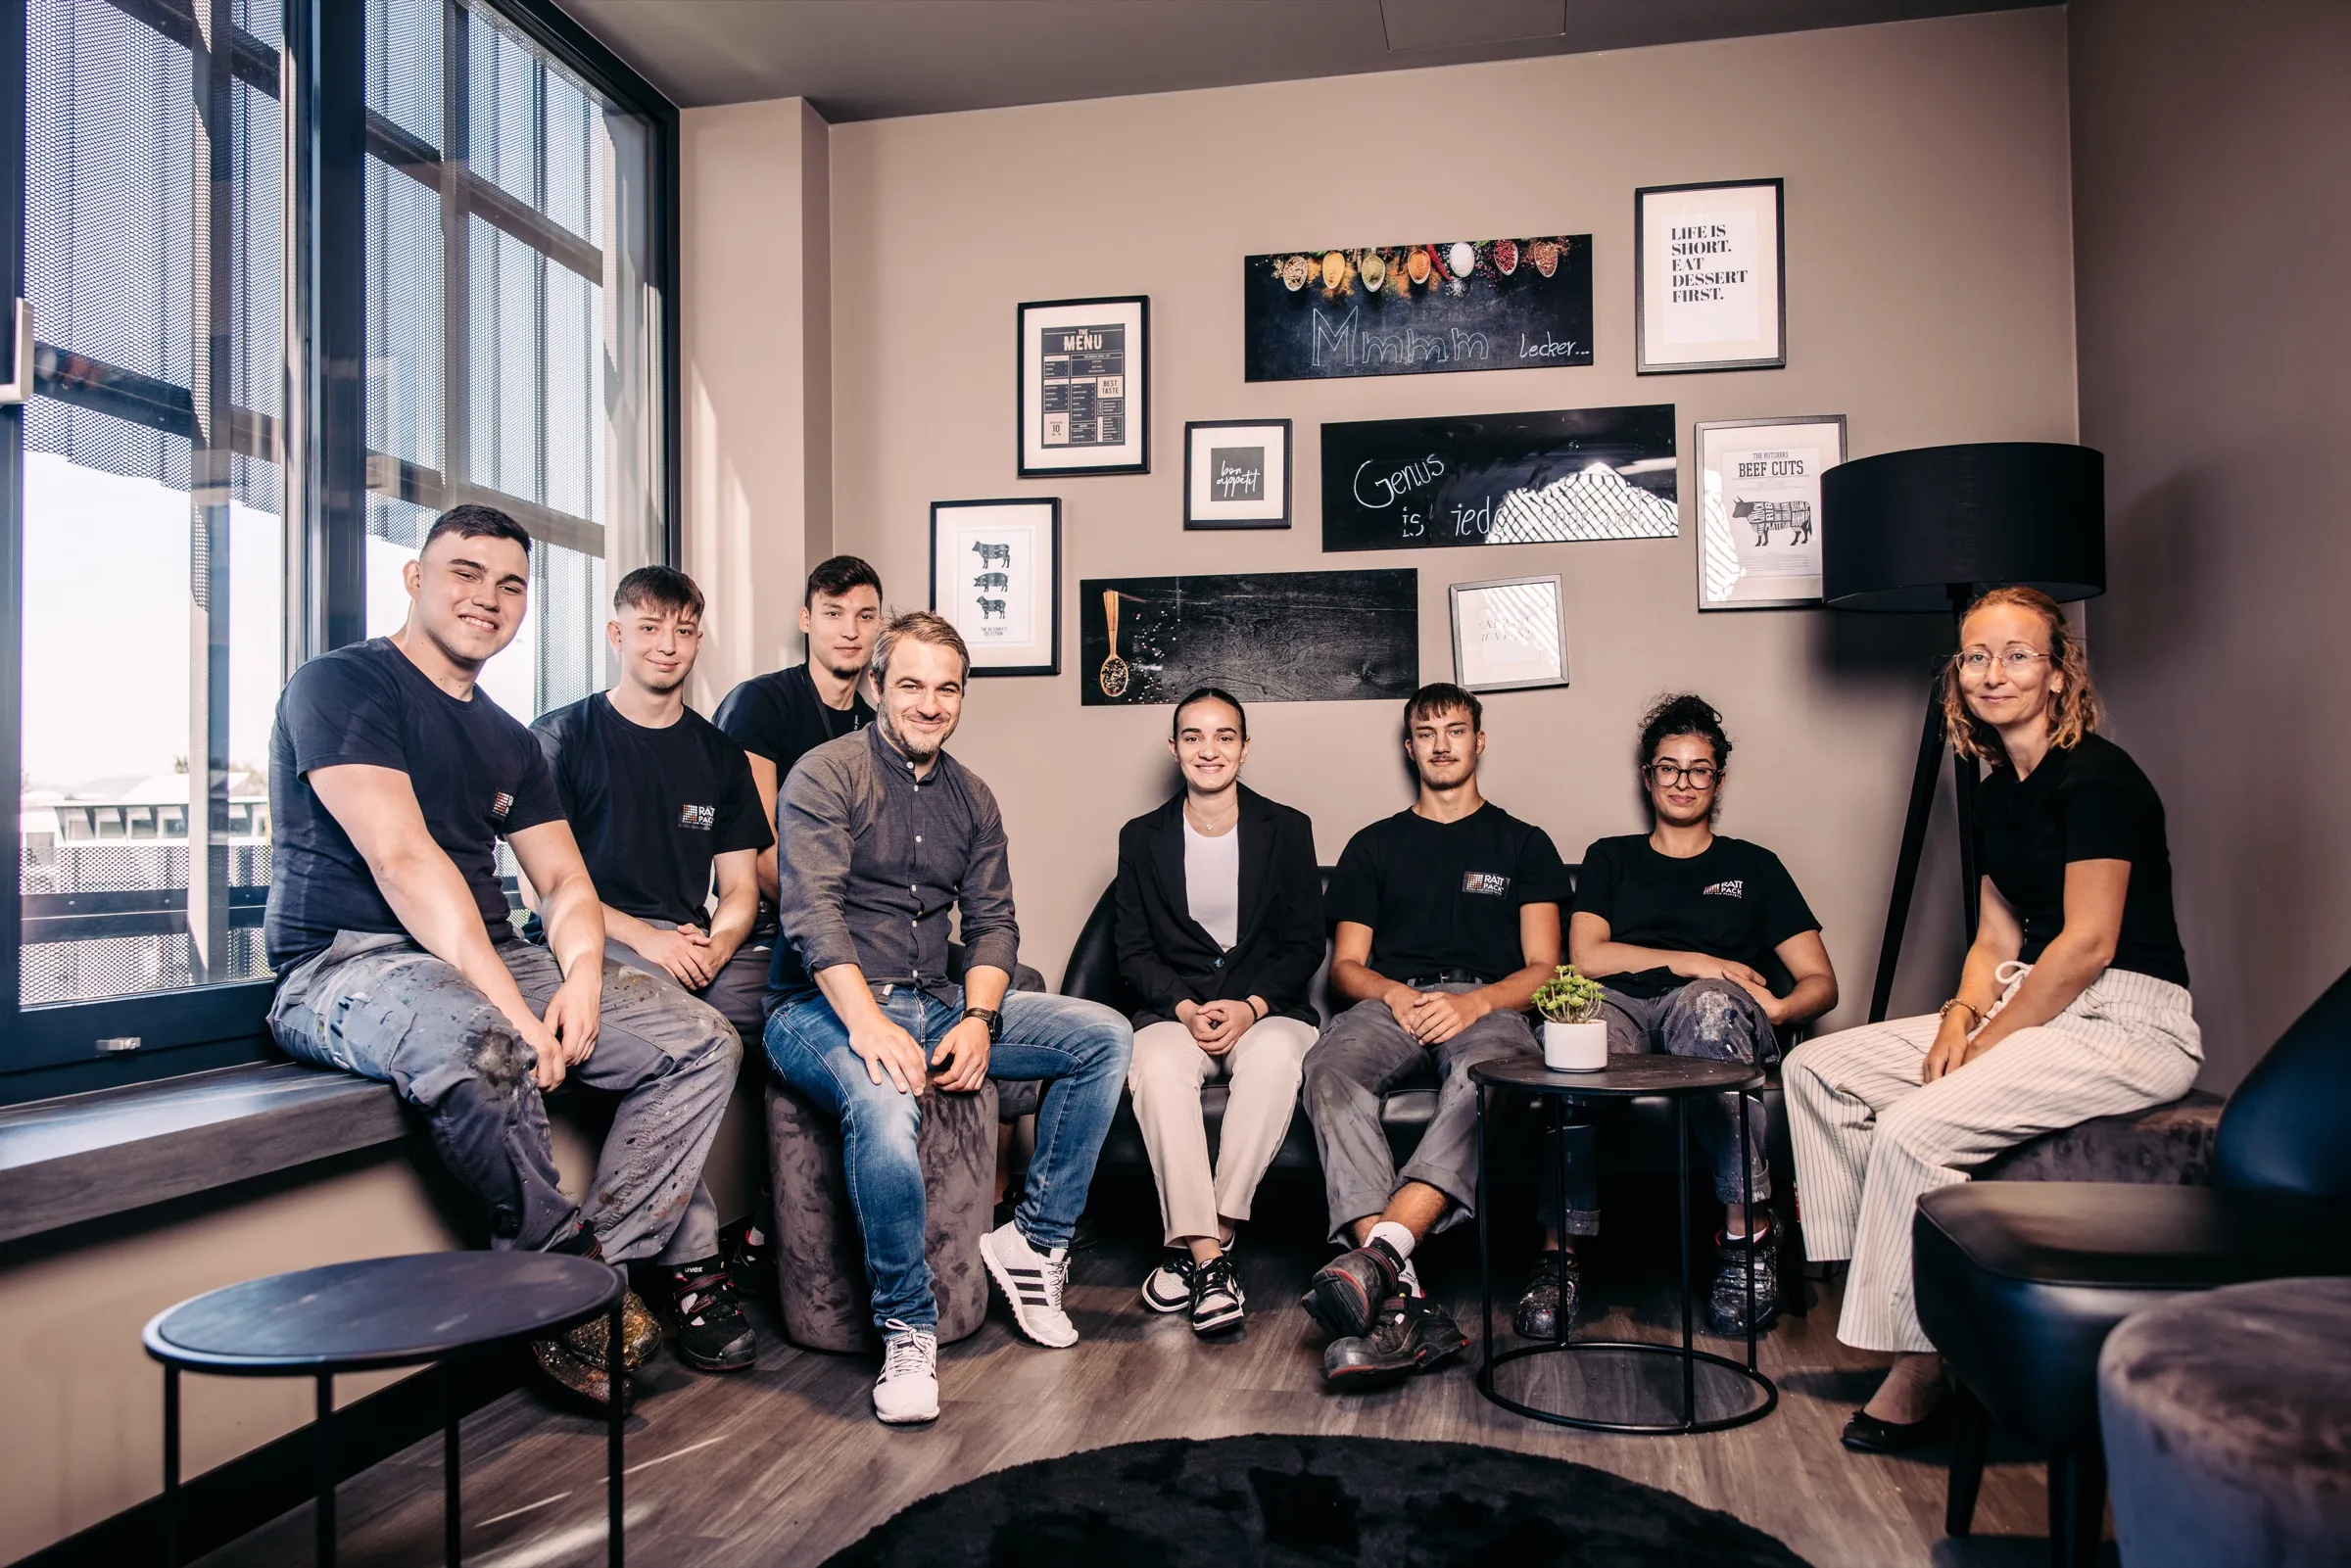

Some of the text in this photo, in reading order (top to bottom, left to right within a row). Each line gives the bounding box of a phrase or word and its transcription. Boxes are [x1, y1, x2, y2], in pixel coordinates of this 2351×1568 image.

[1671, 224, 1726, 241] LIFE IS
[1671, 240, 1732, 257] SHORT.
[1672, 258, 1704, 271] EAT
[1673, 270, 1749, 287] DESSERT
[1673, 288, 1724, 303] FIRST.
[1063, 334, 1103, 352] MENU
[1052, 424, 1061, 433] 10
[1221, 459, 1242, 476] bon
[1738, 459, 1804, 478] BEEF CUTS
[698, 806, 715, 817] RAT
